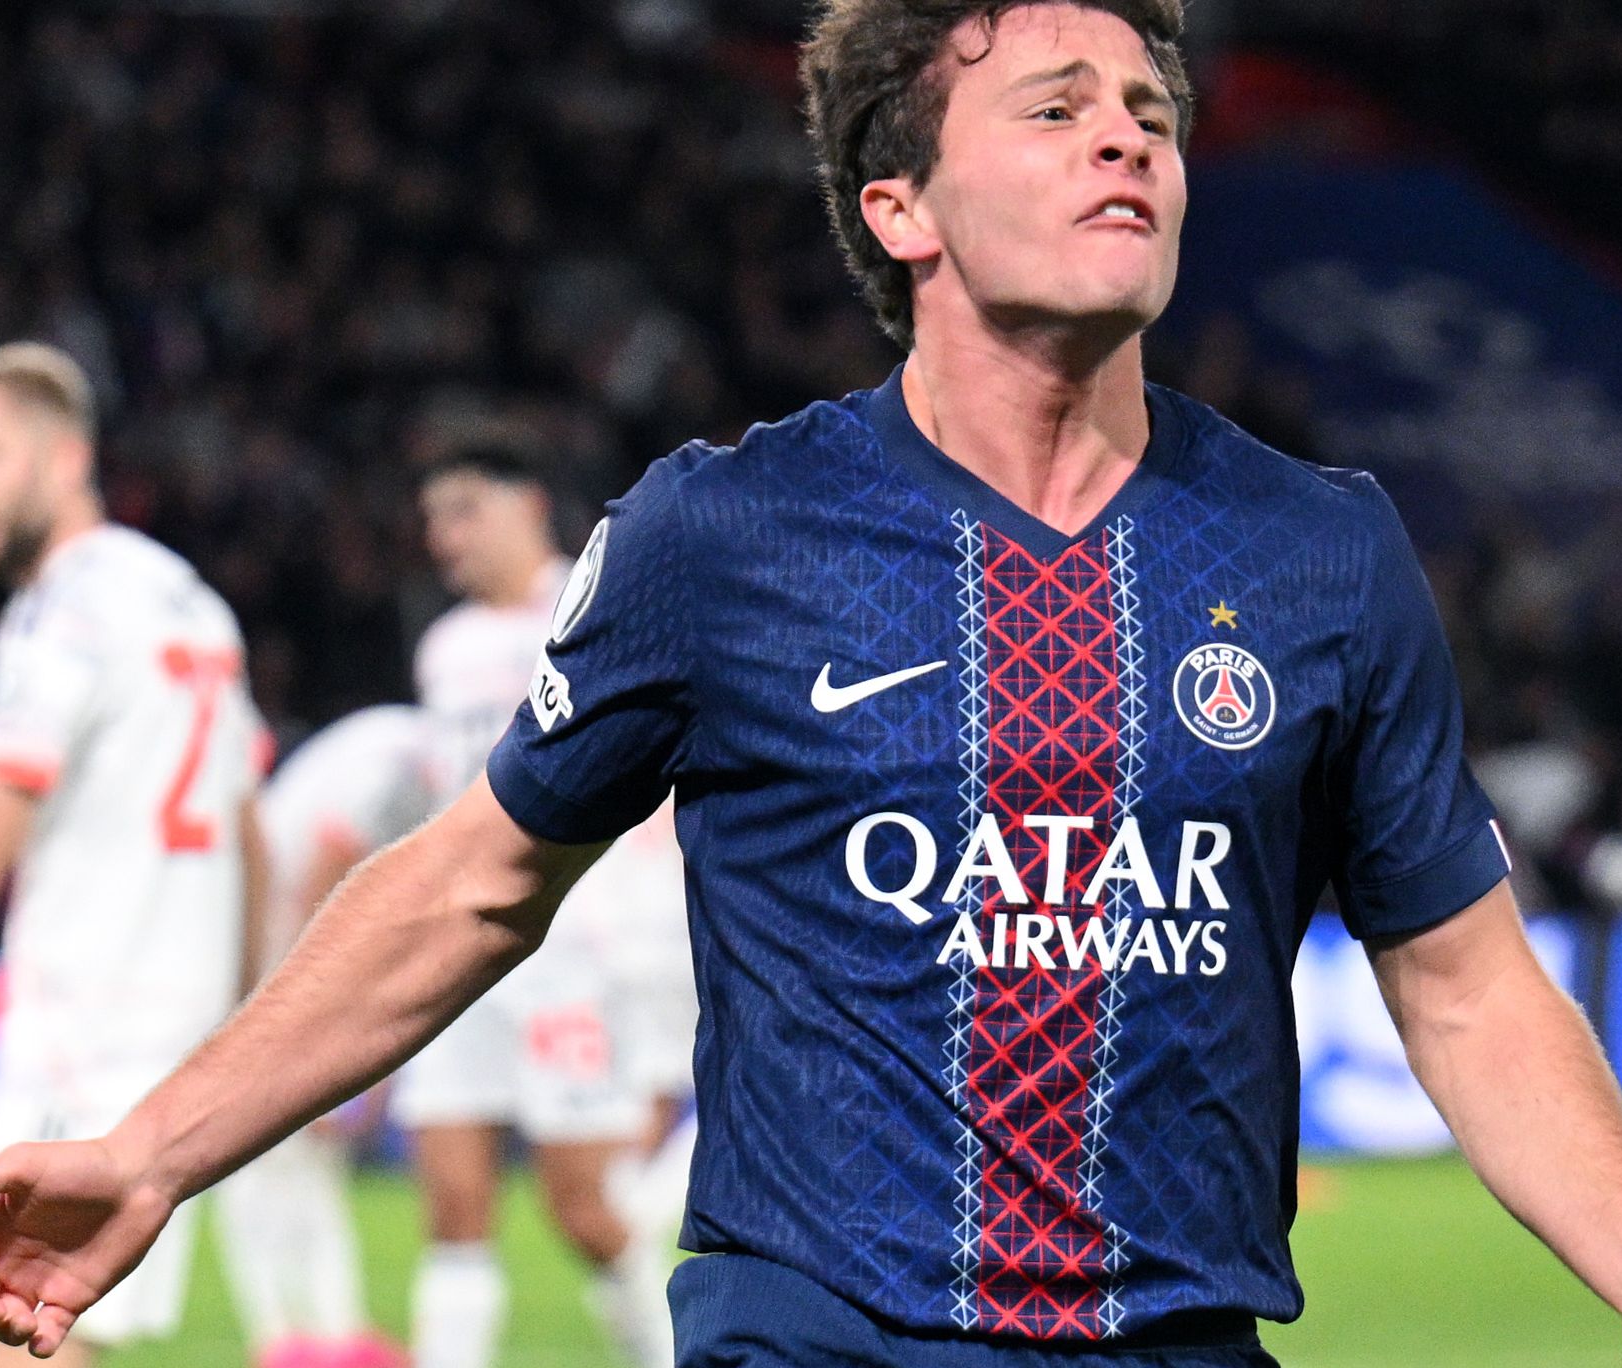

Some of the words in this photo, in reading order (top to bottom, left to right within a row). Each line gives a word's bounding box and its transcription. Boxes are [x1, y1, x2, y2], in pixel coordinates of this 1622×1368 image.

[1189, 648, 1257, 678] PARIS
[845, 811, 1231, 925] QATAR
[935, 911, 1228, 977] AIRWAYS
